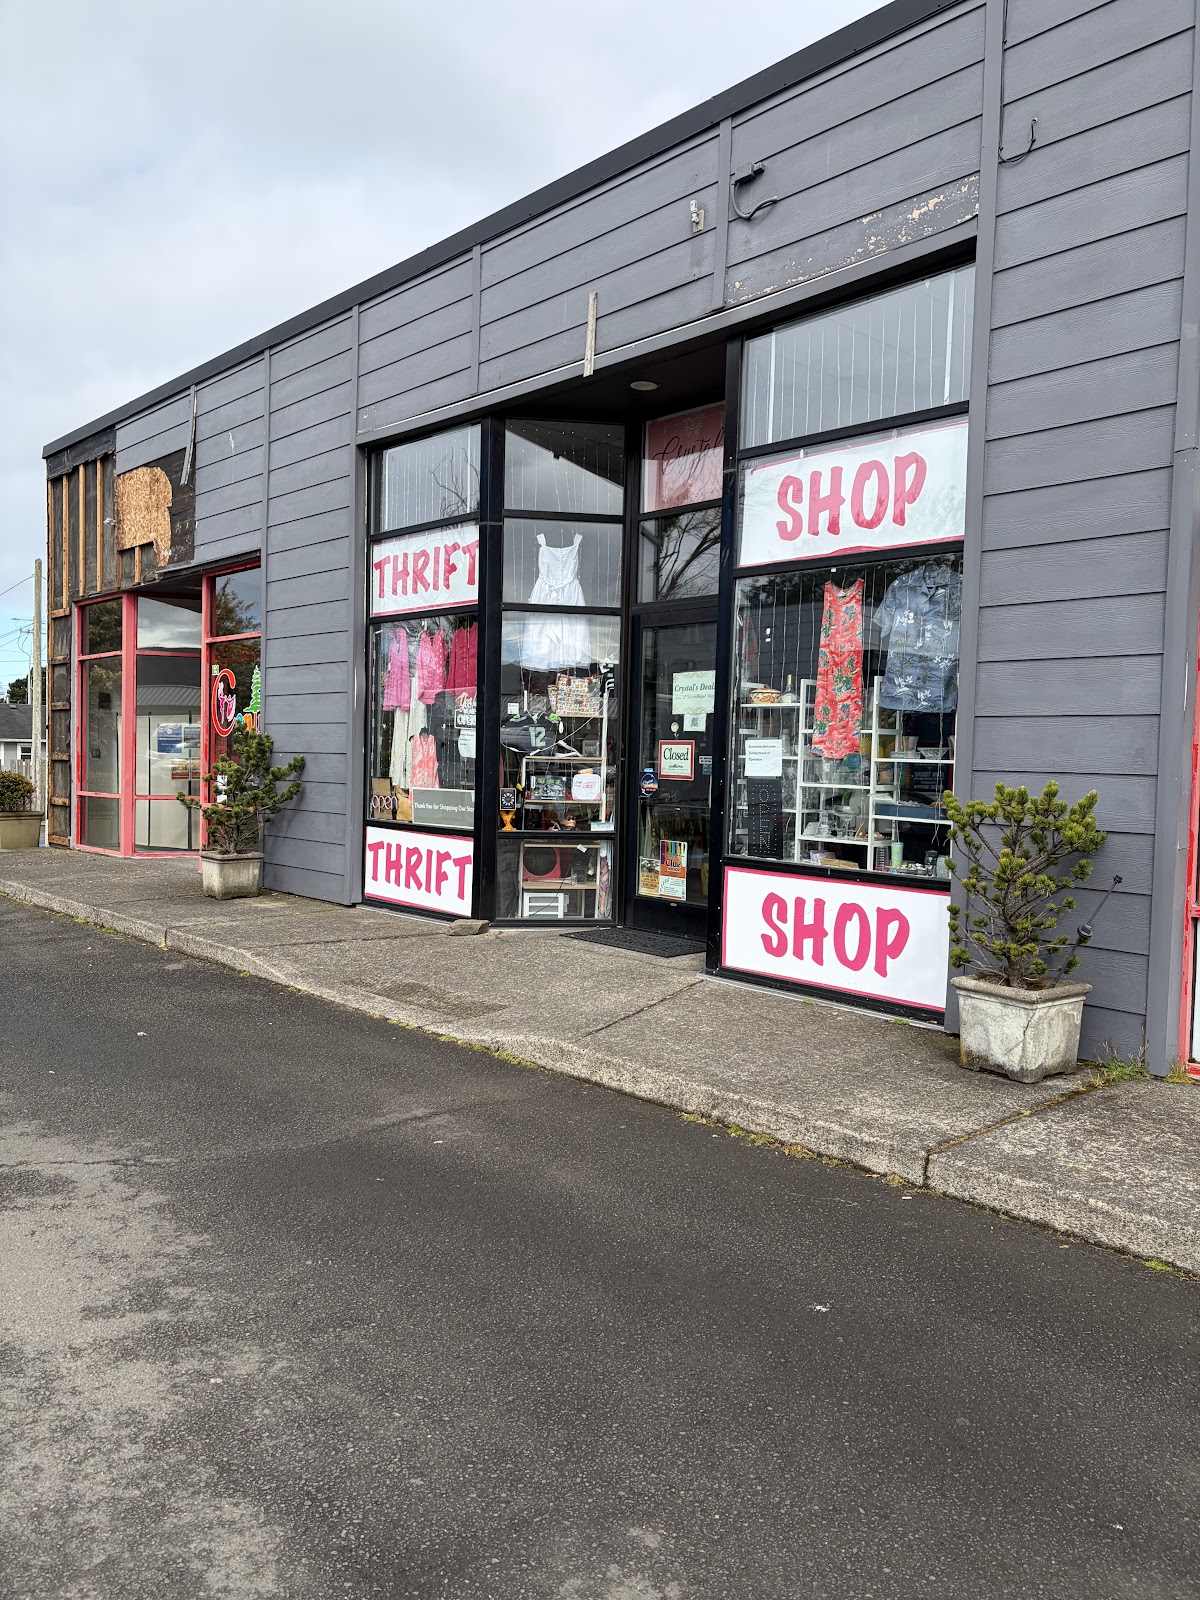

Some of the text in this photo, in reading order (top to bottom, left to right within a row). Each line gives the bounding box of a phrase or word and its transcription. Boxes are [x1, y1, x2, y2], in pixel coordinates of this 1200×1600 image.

[776, 451, 928, 542] SHOP
[373, 540, 480, 599] THRIFT
[674, 683, 699, 695] Crystal's
[457, 714, 477, 726] OPEN
[528, 726, 547, 748] 12
[663, 747, 690, 762] Closed
[372, 795, 399, 812] open
[439, 803, 458, 813] Shopping
[466, 805, 475, 813] Stor
[759, 788, 771, 850] OPEN
[367, 840, 473, 901] THRIFT
[665, 858, 682, 868] Clue
[760, 891, 911, 979] SHOP
